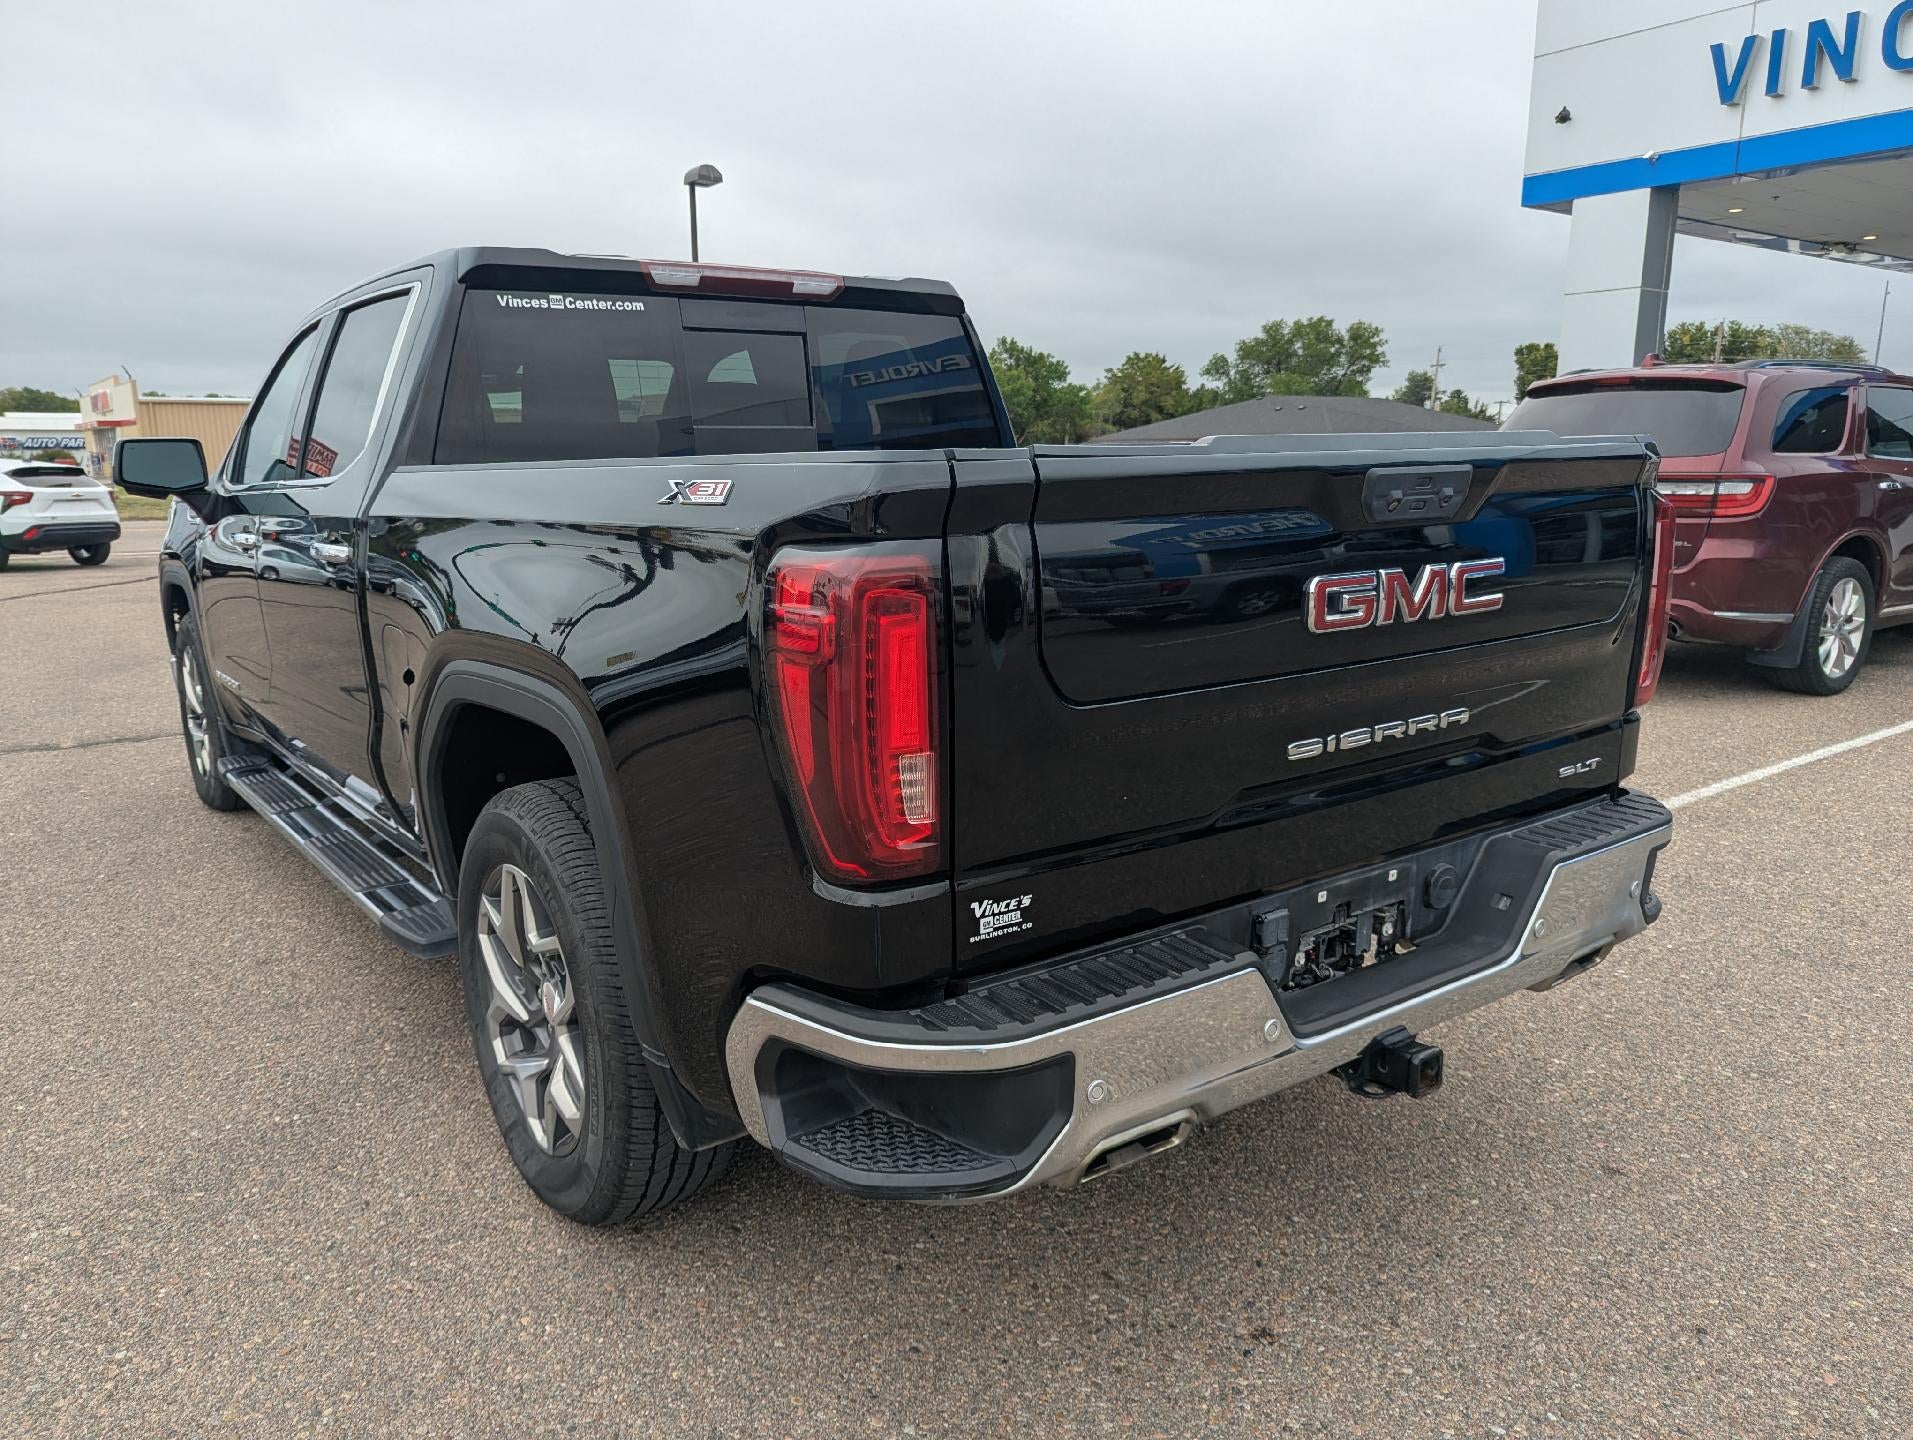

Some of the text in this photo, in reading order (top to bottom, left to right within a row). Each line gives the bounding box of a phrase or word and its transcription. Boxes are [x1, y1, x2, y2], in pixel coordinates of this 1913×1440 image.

[565, 297, 645, 311] Center.com
[23, 438, 58, 449] AUTO
[1304, 557, 1505, 634] GMC
[1286, 707, 1470, 761] SIERRA
[1557, 757, 1602, 779] SLT
[994, 910, 1021, 925] CENTER
[969, 922, 1033, 943] BURLINGTON, CO
